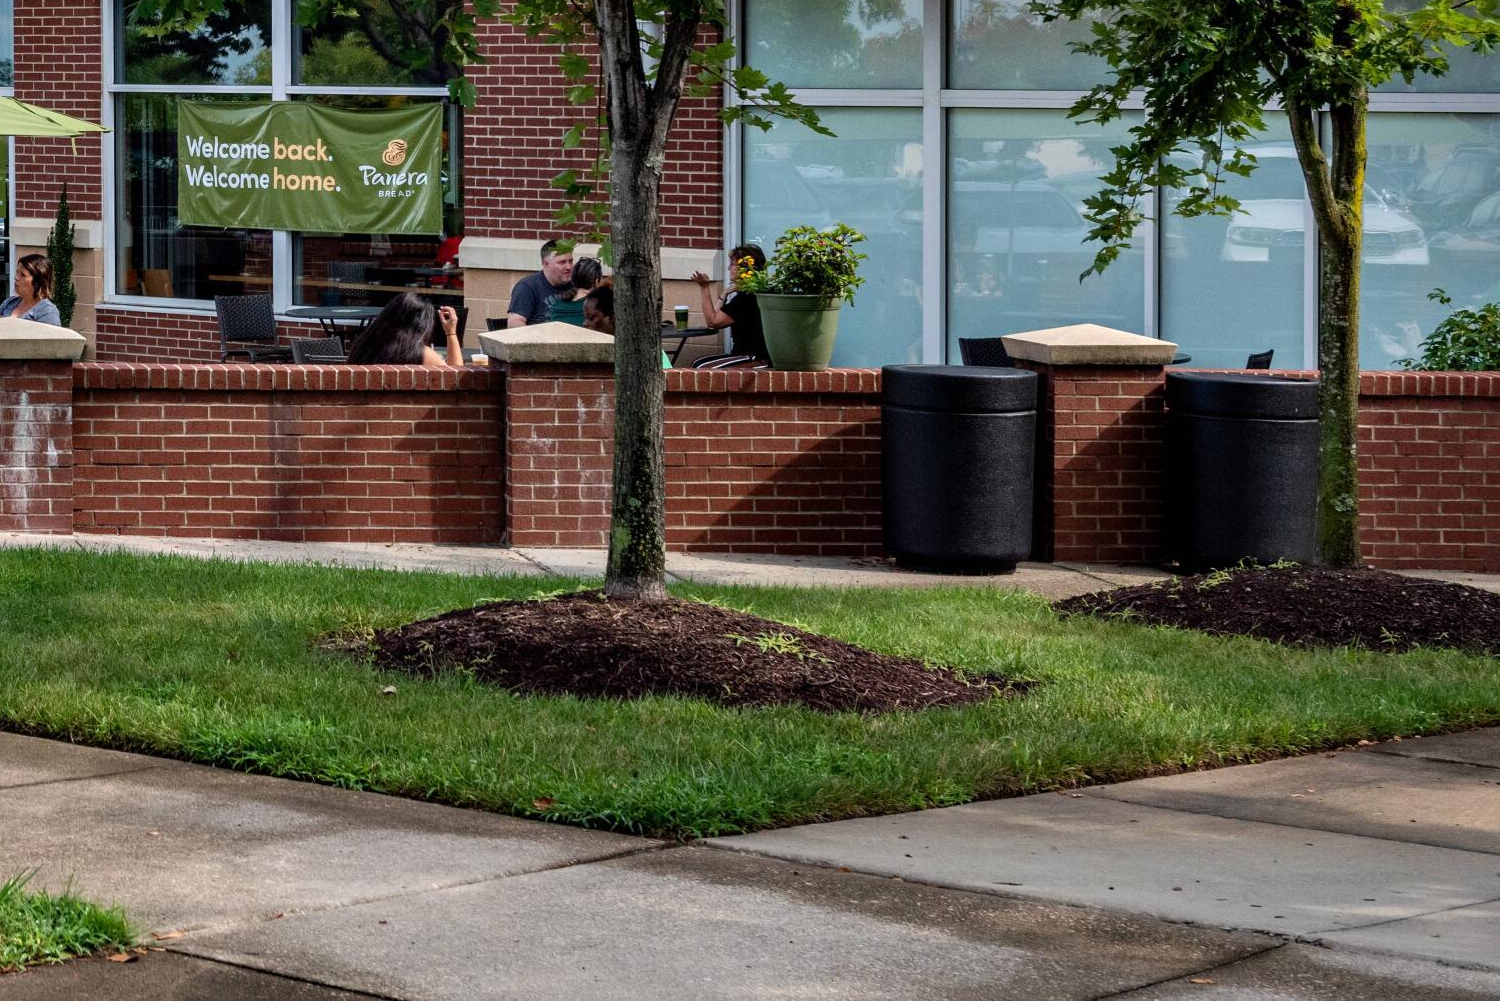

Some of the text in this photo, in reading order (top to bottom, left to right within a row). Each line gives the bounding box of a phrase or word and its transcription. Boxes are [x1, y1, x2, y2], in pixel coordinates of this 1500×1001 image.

[186, 135, 333, 162] Welcome back.
[185, 164, 341, 192] Welcome home.
[358, 165, 428, 186] Panera
